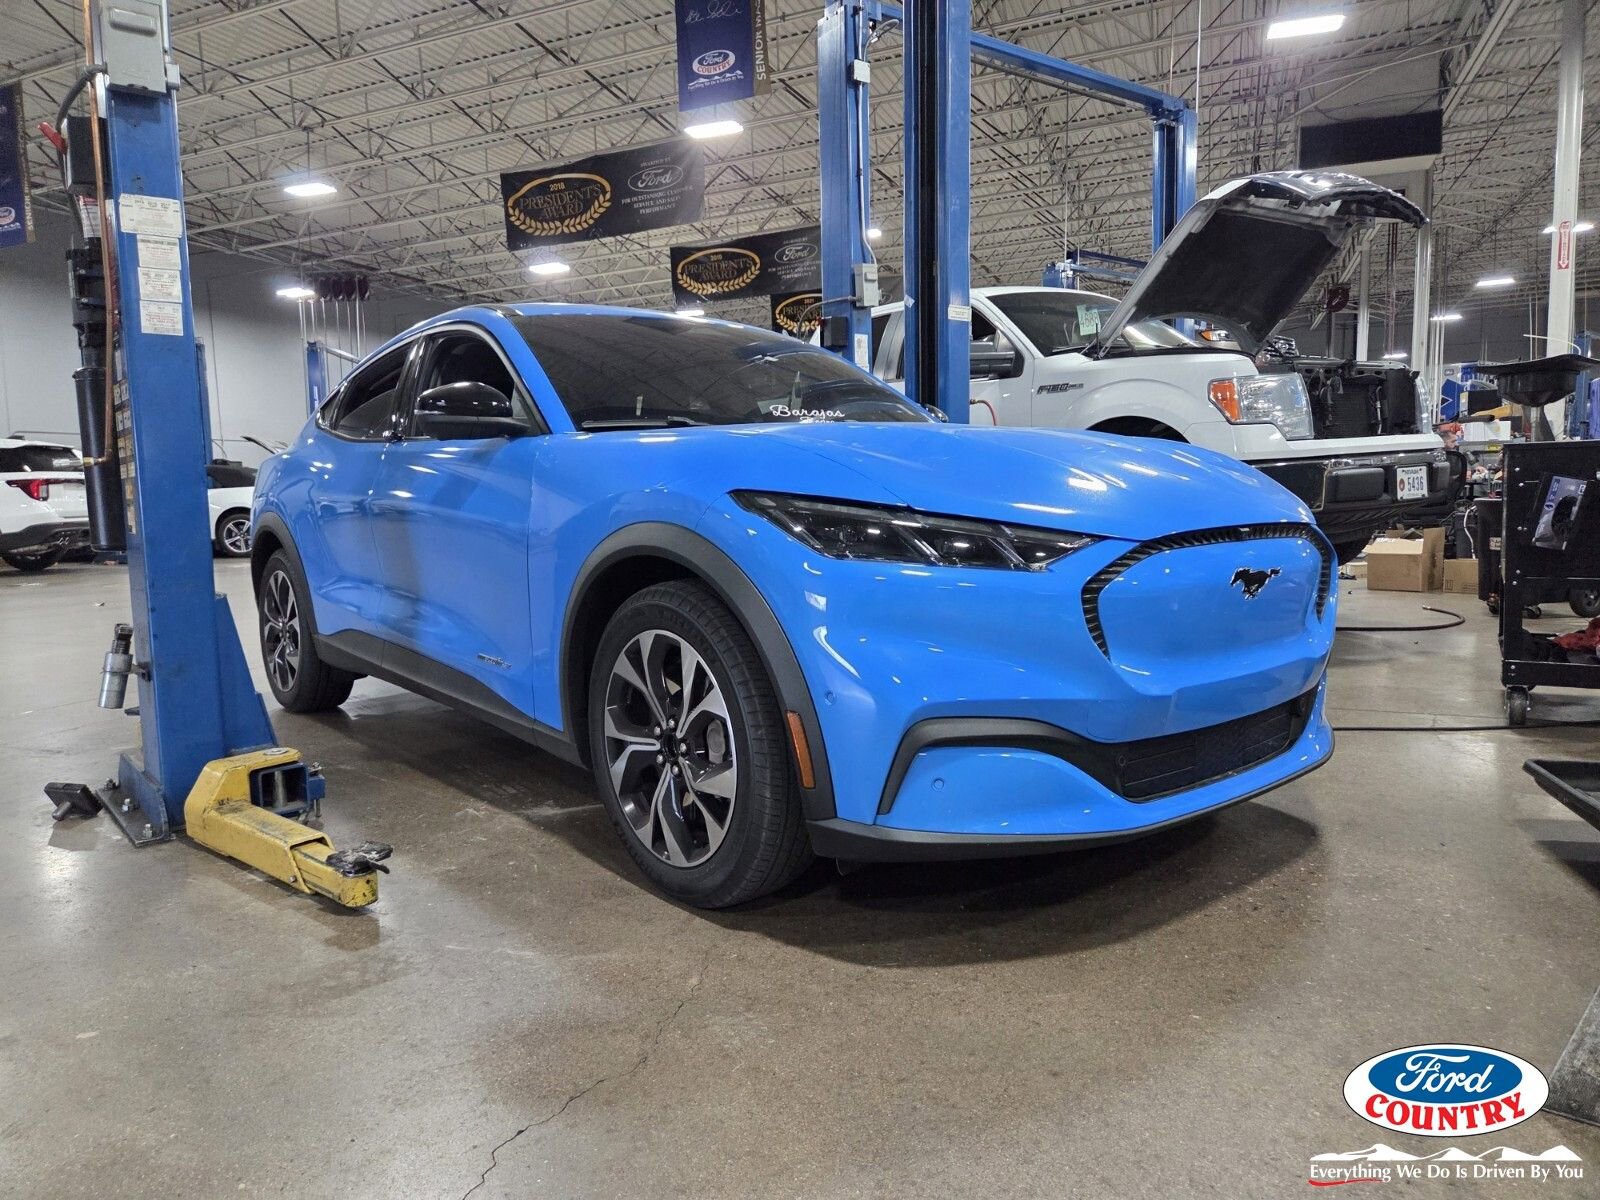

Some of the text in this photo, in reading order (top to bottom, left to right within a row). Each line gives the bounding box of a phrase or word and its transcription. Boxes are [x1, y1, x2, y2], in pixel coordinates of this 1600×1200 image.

[703, 52, 724, 66] Ford
[755, 30, 766, 81] SENIOR
[696, 60, 731, 74] COUNTRY
[637, 168, 673, 188] Ford
[549, 182, 566, 191] 2018
[519, 183, 602, 209] PRESIDENT'S
[543, 201, 584, 219] AWARD
[782, 245, 810, 261] Ford
[684, 257, 753, 275] PRESIDENT'S
[702, 270, 737, 281] AWARD
[769, 404, 846, 420] Barajas
[1407, 476, 1424, 492] 5436
